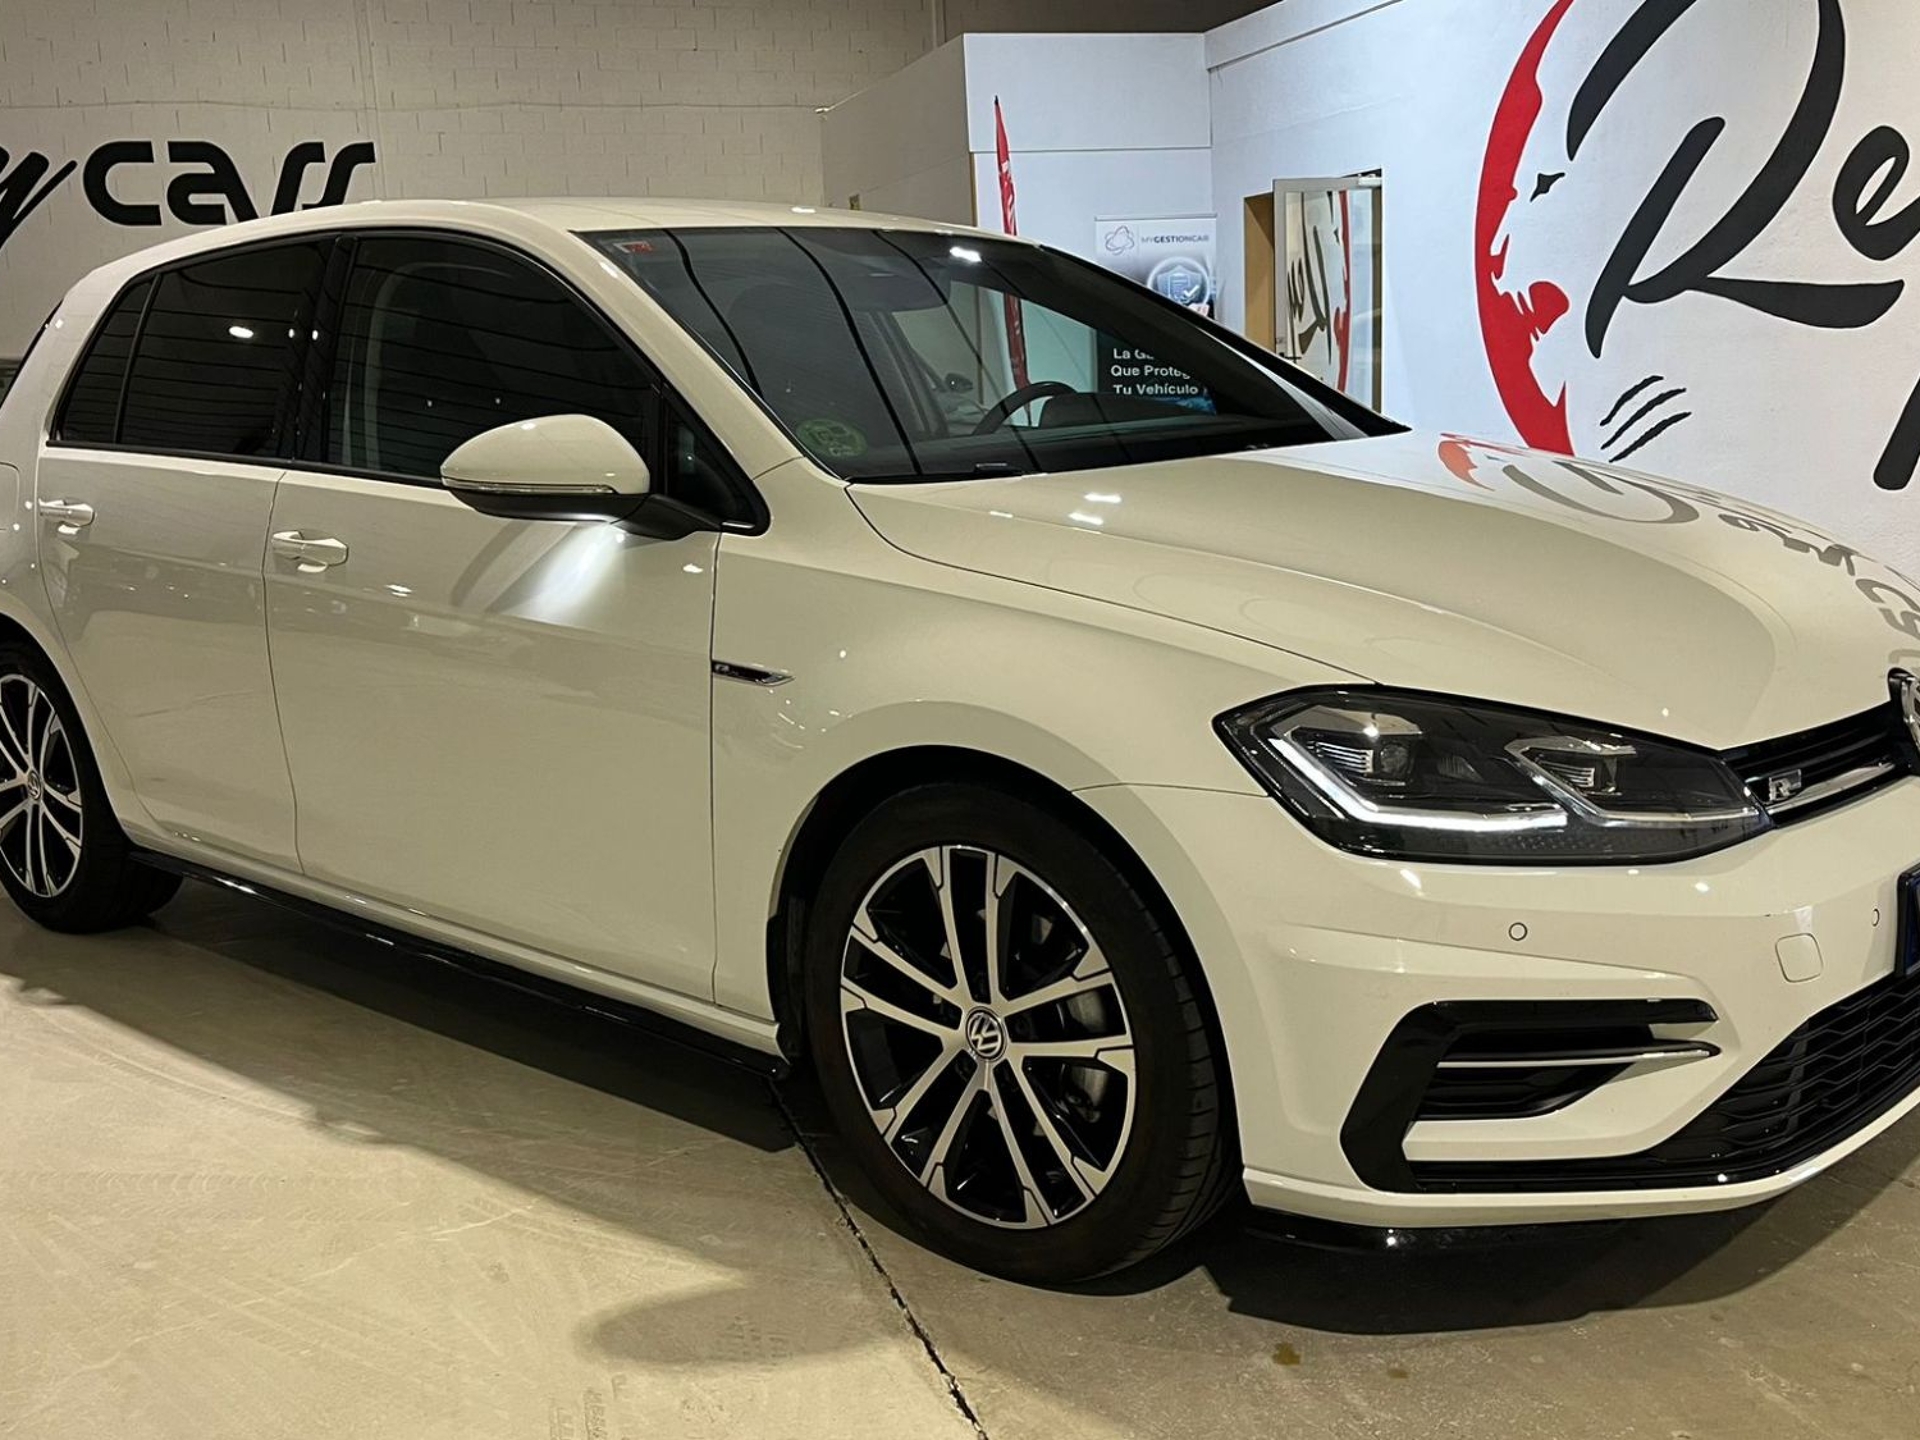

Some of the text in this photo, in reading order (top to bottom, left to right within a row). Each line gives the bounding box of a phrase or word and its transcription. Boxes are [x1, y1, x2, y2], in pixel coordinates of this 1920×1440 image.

[1113, 348, 1131, 359] La
[1110, 364, 1191, 380] Que Proteg
[1113, 382, 1199, 395] Tu Vehículo
